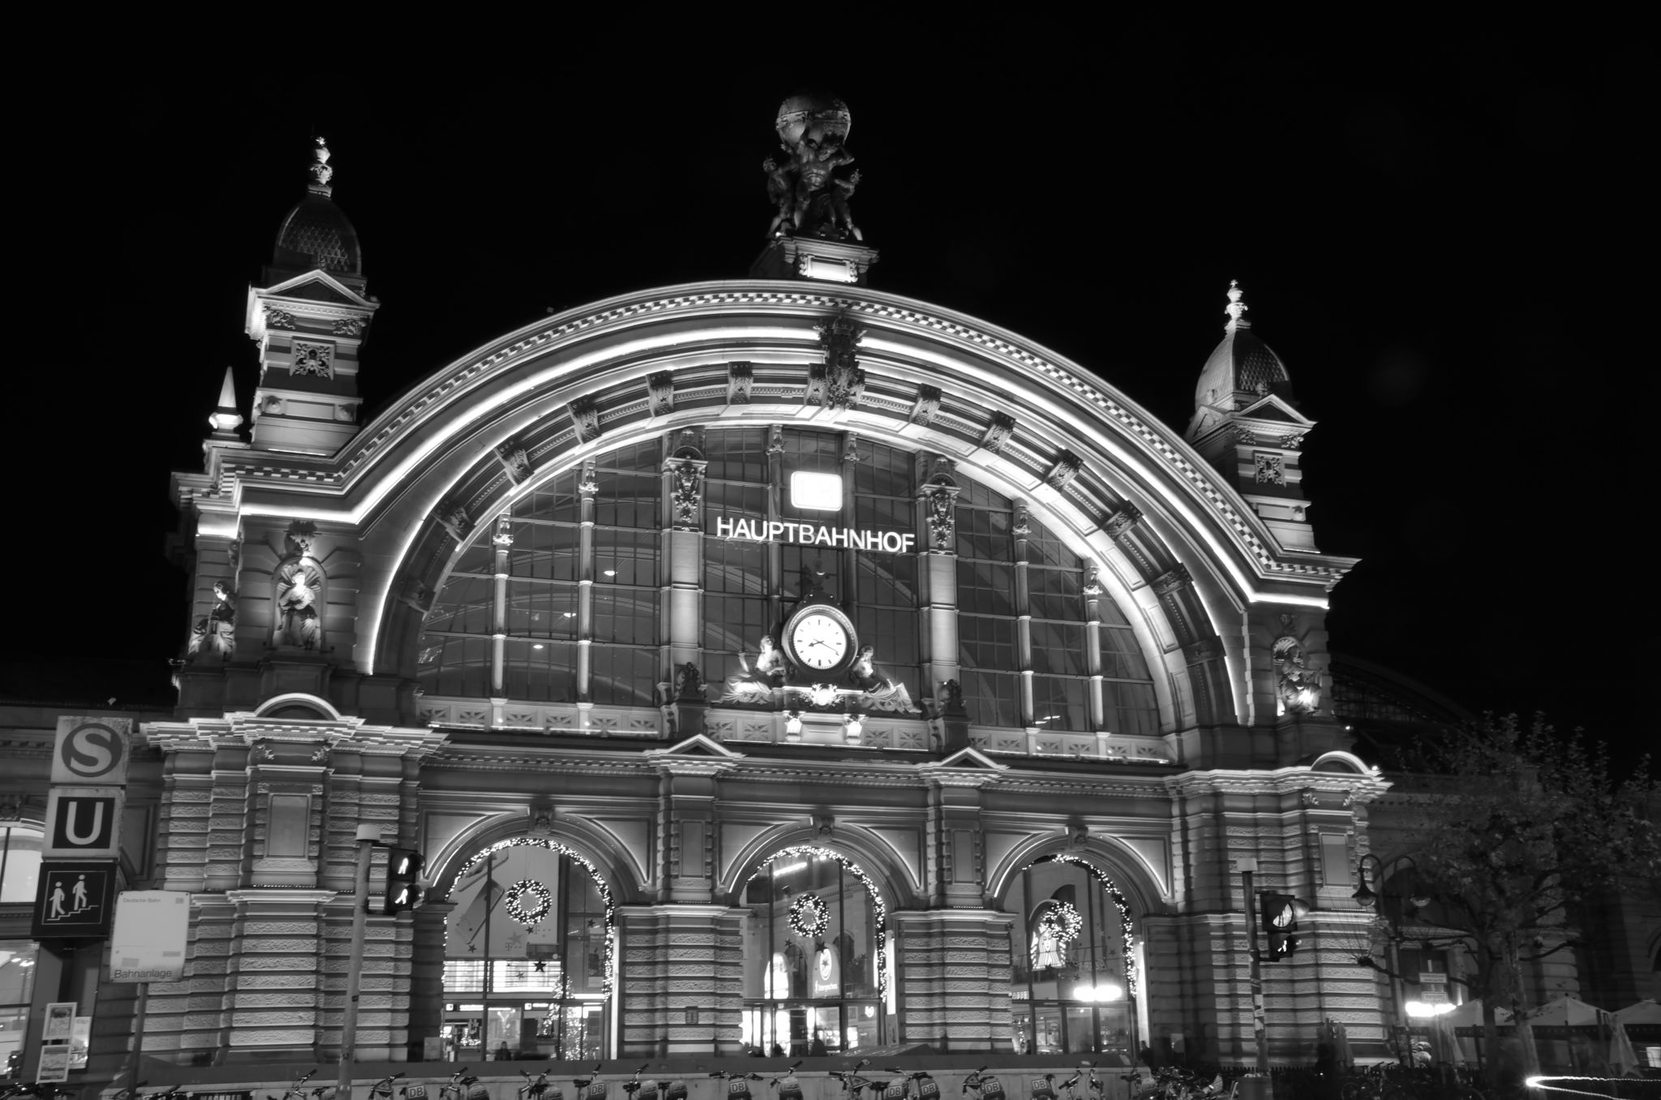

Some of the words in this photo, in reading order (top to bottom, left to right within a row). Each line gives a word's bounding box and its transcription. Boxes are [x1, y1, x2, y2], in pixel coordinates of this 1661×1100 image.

[716, 516, 915, 553] HAUPTBAHNHOF
[69, 727, 113, 775] S
[65, 801, 104, 845] U
[409, 1086, 424, 1098] DB
